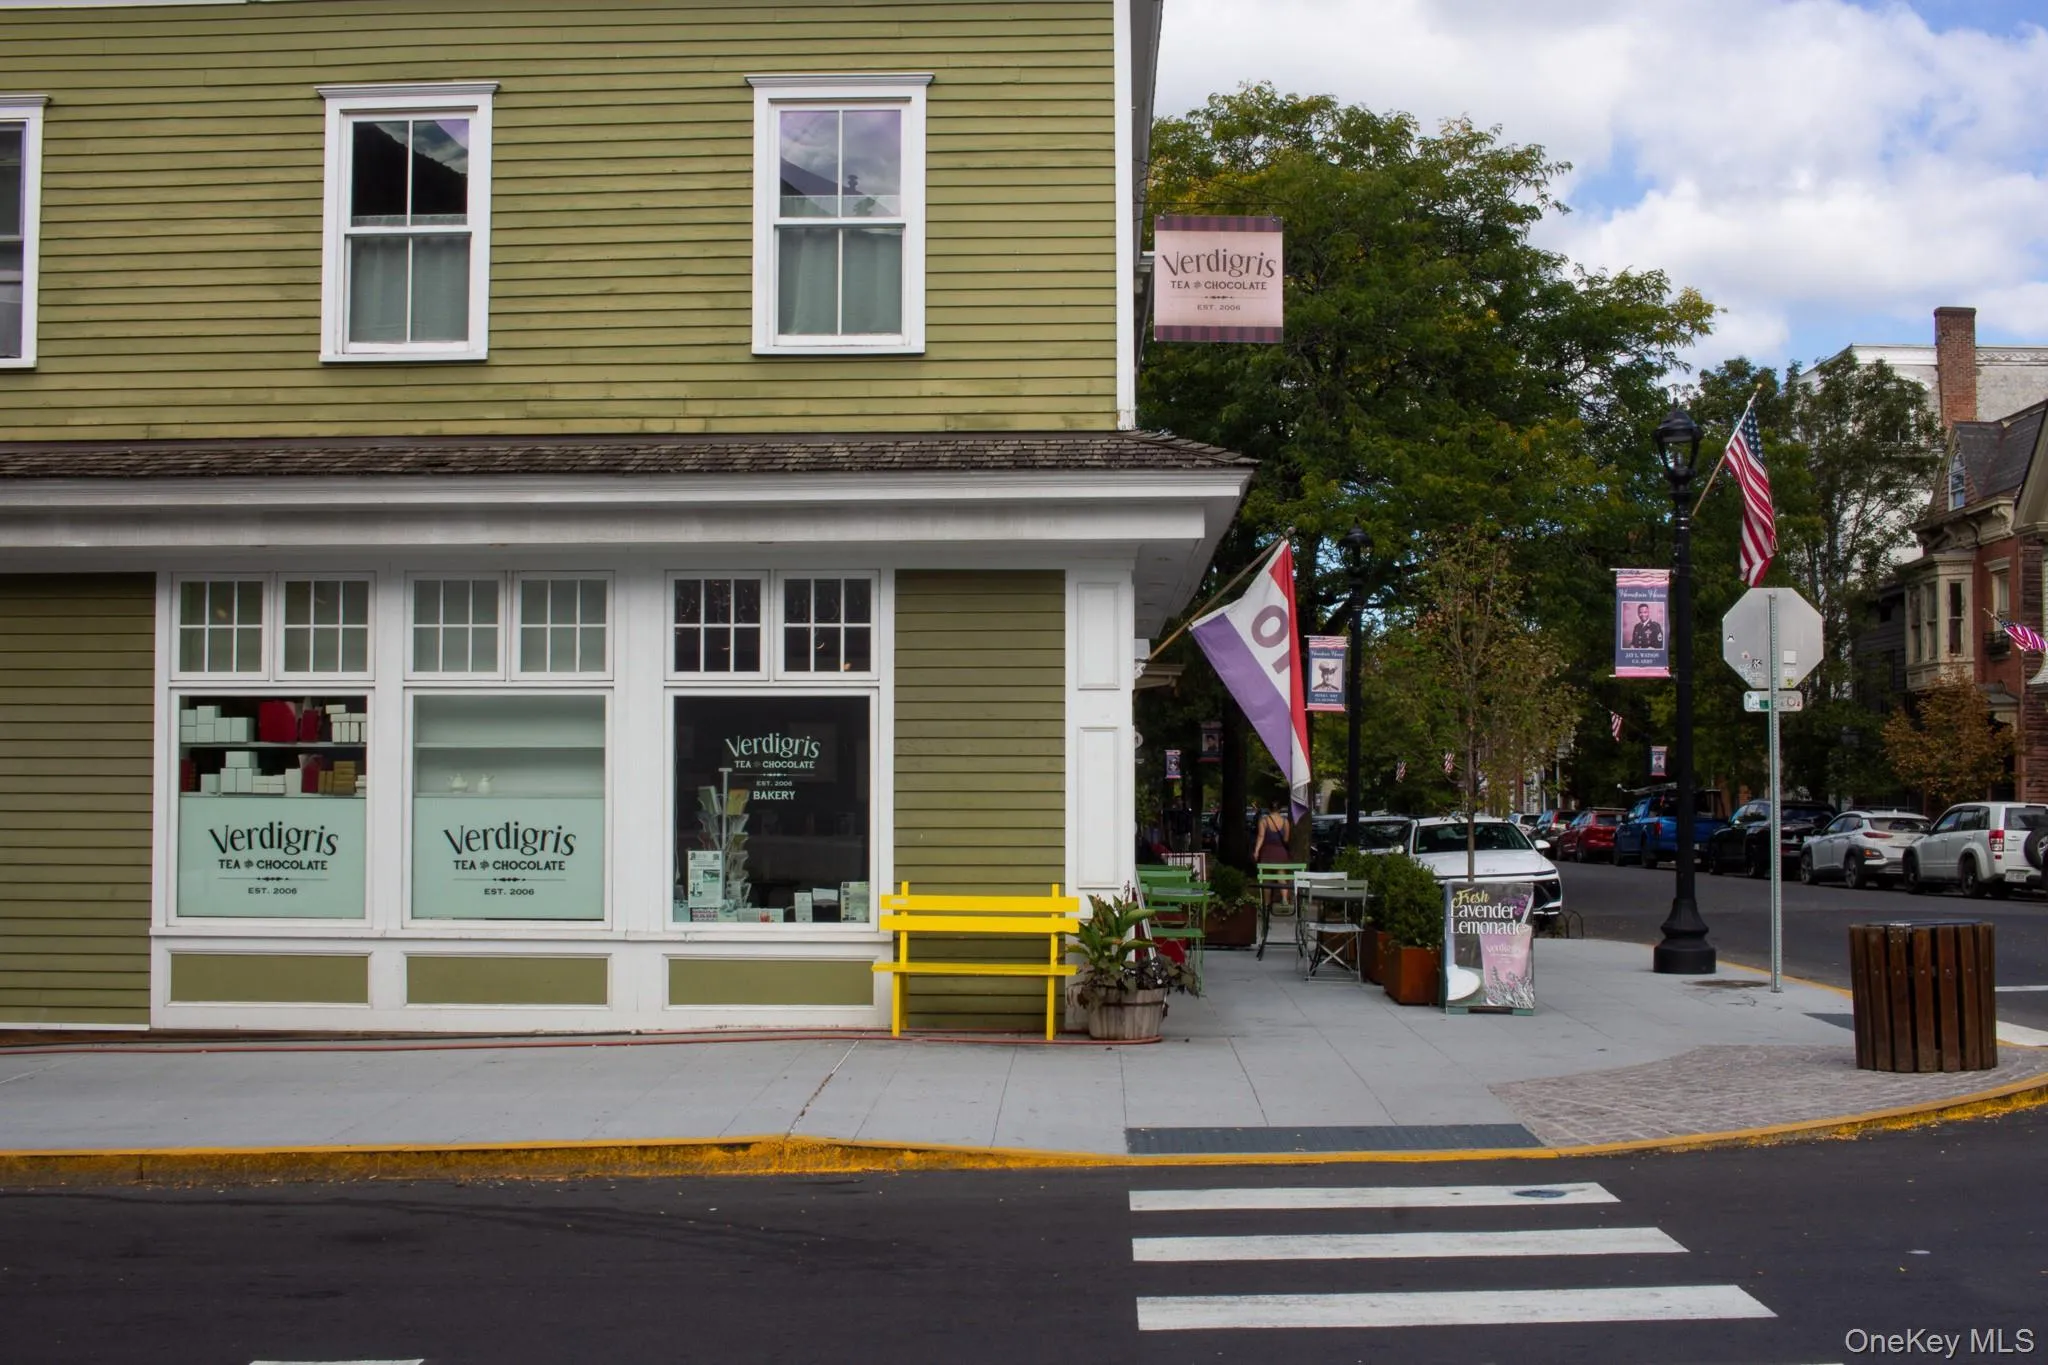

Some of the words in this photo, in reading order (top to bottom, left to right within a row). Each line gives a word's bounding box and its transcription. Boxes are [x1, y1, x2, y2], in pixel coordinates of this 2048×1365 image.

[1162, 248, 1277, 278] Verdigris
[1171, 281, 1190, 289] TEA
[1204, 281, 1267, 290] CHOCOLATE
[725, 733, 821, 759] Verdigris
[734, 761, 752, 769] TEA
[762, 761, 815, 769] CHOCOLATE
[753, 791, 796, 801] BAKERY
[208, 820, 339, 856] Verdigris
[443, 820, 577, 856] Verdigris
[218, 859, 241, 869] TEA
[256, 859, 328, 870] CHOCOLATE
[453, 860, 477, 870] TEA
[492, 860, 566, 871] CHOCOLATE
[248, 887, 270, 895] EST.
[273, 887, 297, 895] 2006
[484, 888, 507, 896] EST.
[509, 888, 535, 896] 2006
[1452, 887, 1490, 907] Fresh
[1450, 902, 1518, 919] Lavender
[1450, 918, 1525, 936] Lemonade
